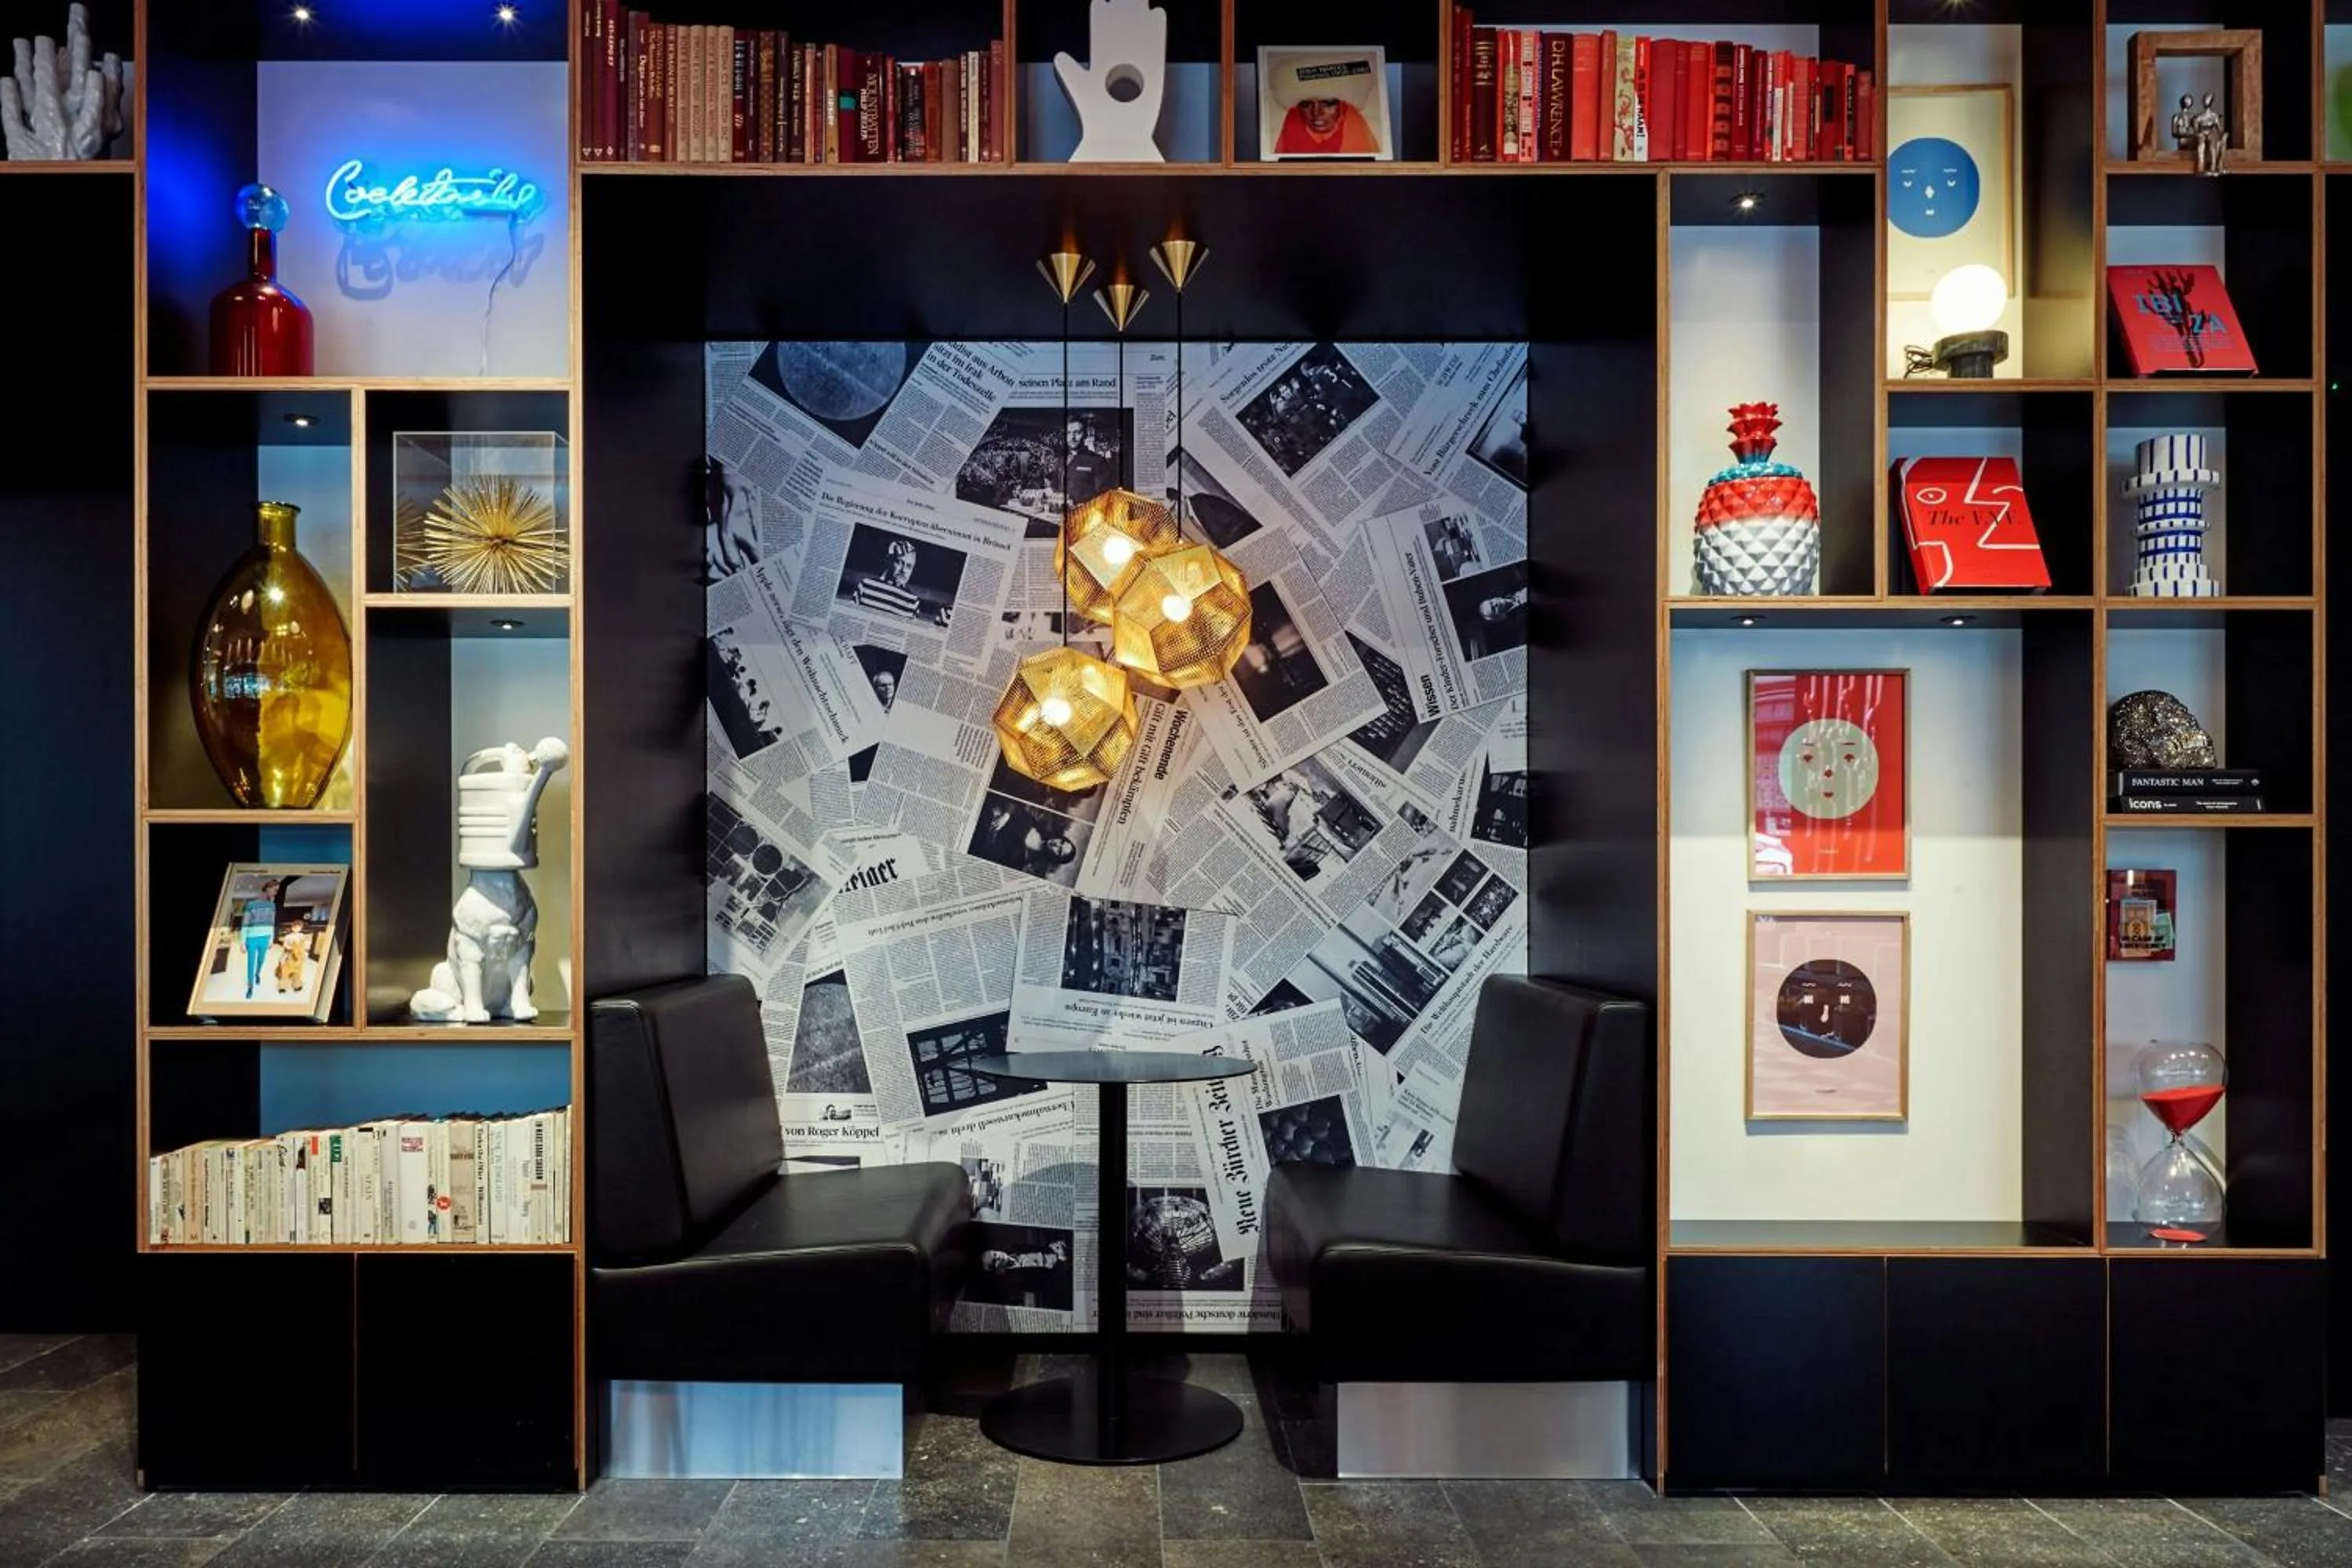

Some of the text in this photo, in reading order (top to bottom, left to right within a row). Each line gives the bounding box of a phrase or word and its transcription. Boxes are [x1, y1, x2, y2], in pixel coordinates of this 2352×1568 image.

[866, 73, 877, 154] MOUNTBATTEN
[927, 351, 995, 401] in der Todeszelle
[952, 354, 964, 368] im
[964, 363, 982, 379] Irak
[989, 365, 1014, 387] Arbon
[1092, 377, 1116, 387] Rand
[821, 492, 833, 501] Die
[837, 496, 873, 514] Regierung
[756, 567, 772, 590] Apple
[1405, 553, 1459, 710] Der Kinder-Forscher und Buben-Vater
[1421, 675, 1439, 717] Wissen
[1155, 710, 1187, 779] Wochenende
[1118, 702, 1165, 824] Gift mit Gift bekämpfen
[2131, 777, 2181, 787] FANTASTIC
[2182, 777, 2205, 786] MAN
[1420, 926, 1512, 1034] Die Welthauptstadt der Hardware
[1065, 1003, 1098, 1016] Europa
[1167, 1017, 1177, 1025] ist
[1179, 1018, 1214, 1029] Ungarn
[785, 1125, 878, 1138] von Roger Köppel
[1196, 1046, 1260, 1234] Neue Zürcher Zeitg
[1156, 1310, 1192, 1320] Politiker
[1196, 1310, 1236, 1320] deutsche
[1237, 1310, 1280, 1320] Hunderte
